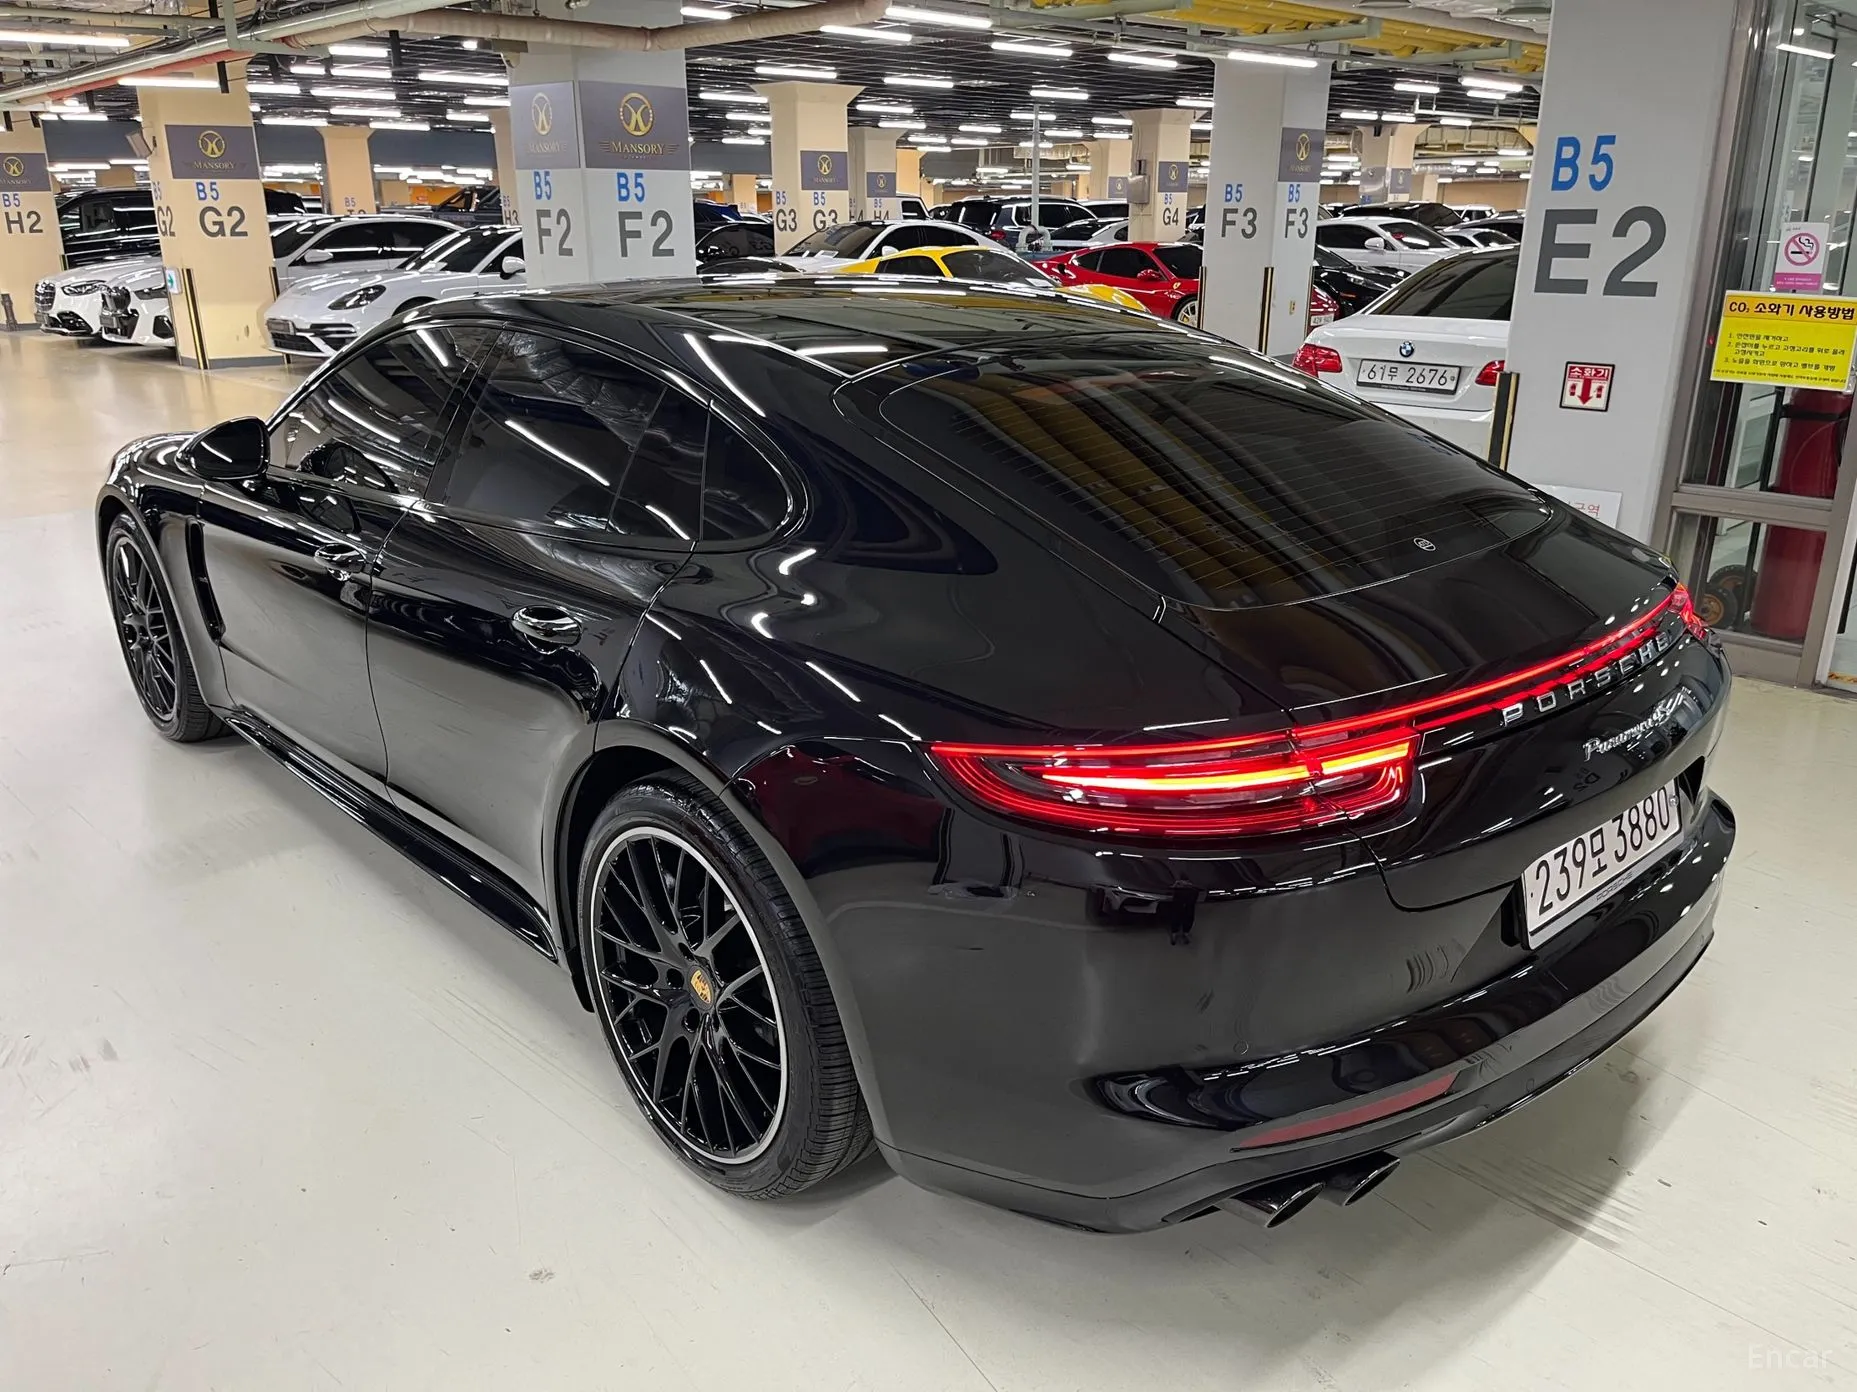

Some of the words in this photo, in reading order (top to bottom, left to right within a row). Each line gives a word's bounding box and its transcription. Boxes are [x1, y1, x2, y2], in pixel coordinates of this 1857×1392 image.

[611, 142, 664, 155] MANSORY
[194, 161, 234, 169] MANSORY
[1551, 134, 1616, 191] B5
[196, 182, 219, 201] B5
[533, 170, 552, 200] B5
[616, 172, 645, 202] B5
[1225, 184, 1243, 202] B5
[1288, 184, 1300, 202] B5
[2, 193, 21, 207] B5
[776, 191, 787, 205] B5
[813, 192, 826, 206] B5
[1164, 194, 1173, 205] B5
[4, 210, 43, 234] H2
[157, 205, 175, 237] G2
[199, 206, 248, 237] G2
[776, 208, 797, 232] G3
[813, 209, 838, 231] G3
[1163, 207, 1179, 226] G4
[1221, 207, 1258, 239] F3
[1285, 207, 1309, 239] F3
[536, 208, 573, 257] F2
[618, 209, 675, 258] F2
[1534, 206, 1667, 297] E2
[1754, 302, 1795, 316] 소화기
[1799, 304, 1855, 320] 사용방법
[1367, 364, 1398, 382] 61무
[1405, 366, 1448, 386] 2676
[1570, 367, 1609, 378] 소화기
[1501, 631, 1669, 727] PORSCHE
[1536, 827, 1608, 916] 239모
[1612, 786, 1670, 863] 3880
